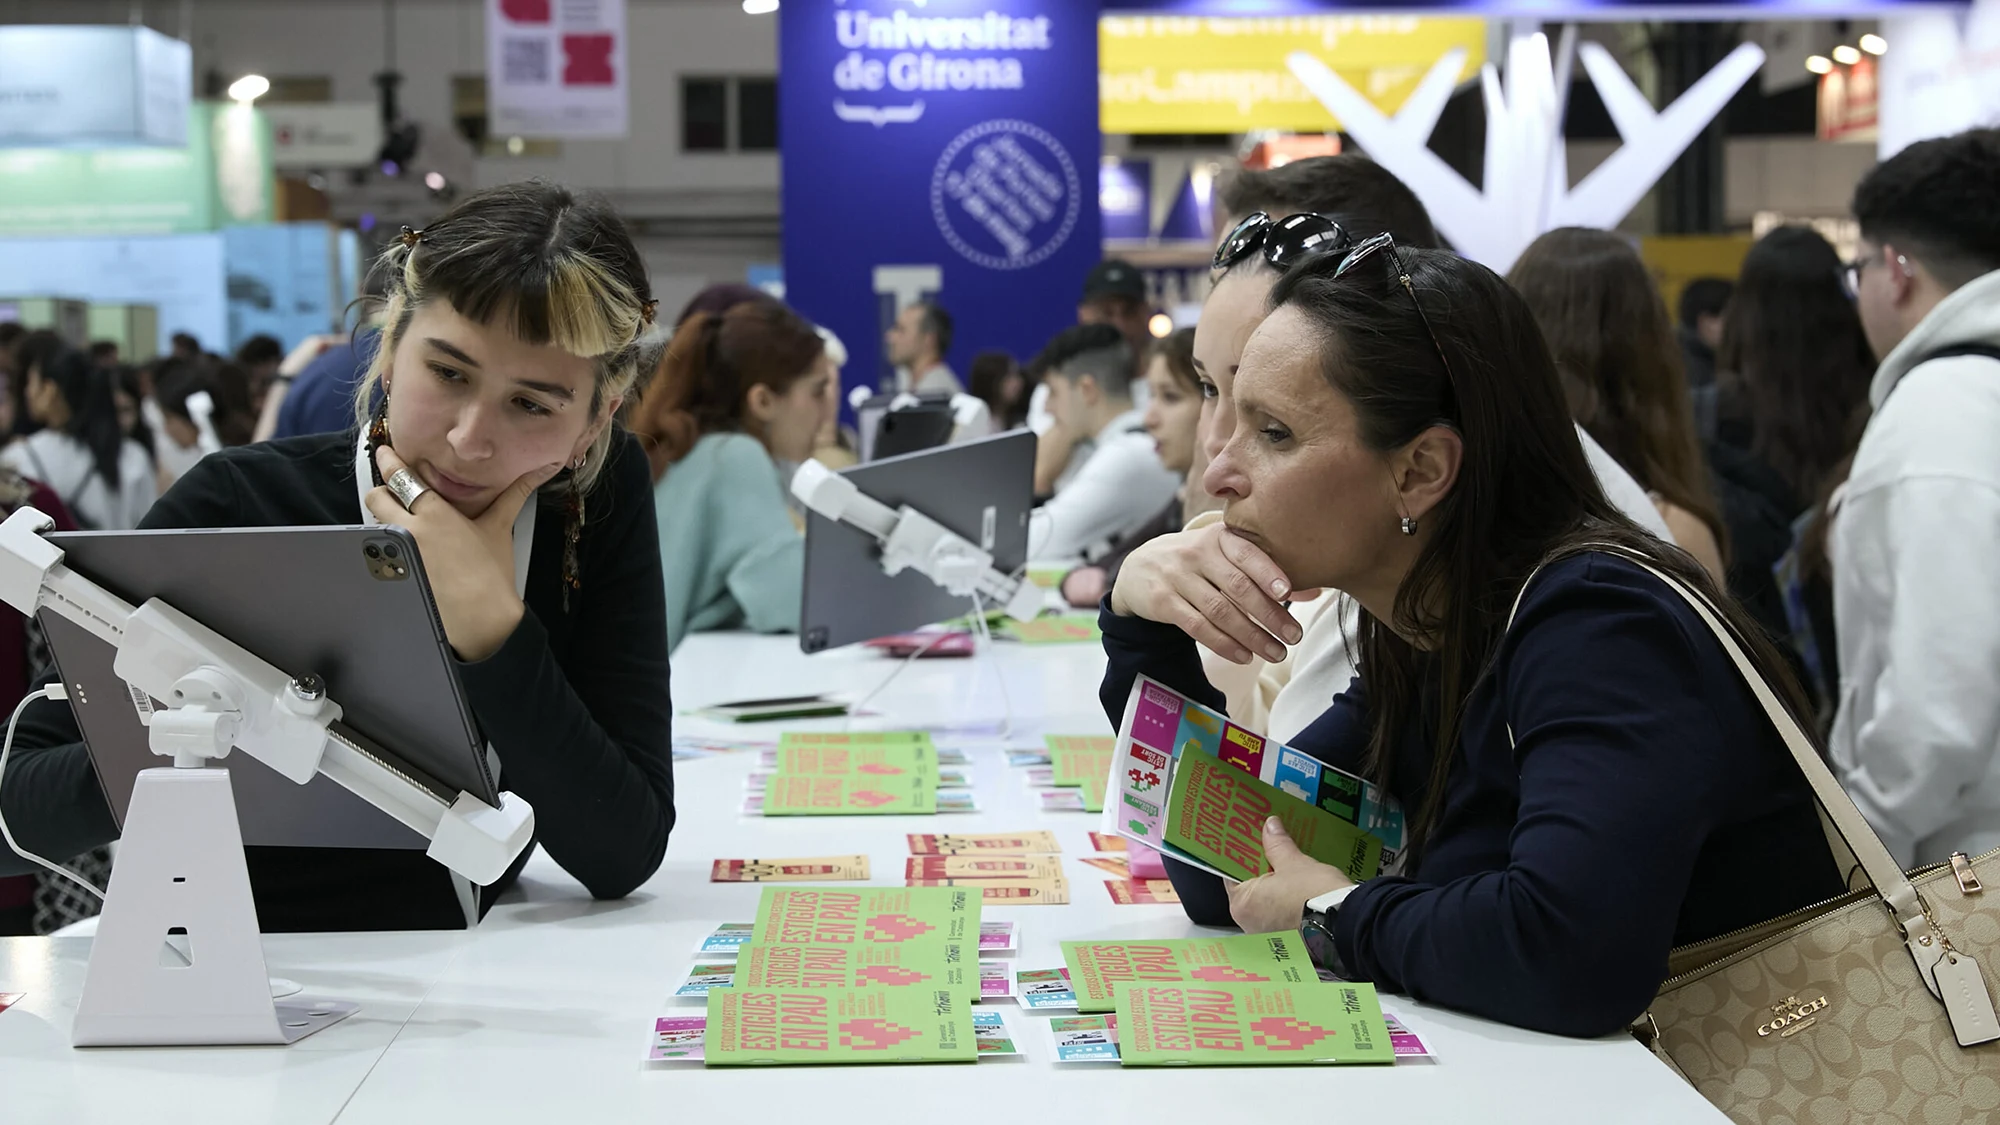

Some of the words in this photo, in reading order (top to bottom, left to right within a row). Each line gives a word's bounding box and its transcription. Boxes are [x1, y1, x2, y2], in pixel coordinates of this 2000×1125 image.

[835, 9, 1053, 50] Universitat
[833, 51, 886, 91] de
[887, 52, 1024, 91] Girona
[1141, 749, 1156, 759] SORT
[1147, 757, 1164, 768] ESTIC
[1243, 740, 1259, 751] ESTIC
[1194, 766, 1236, 856] ESTIGUES
[1228, 781, 1272, 847] PAU
[1224, 833, 1261, 876] EN
[781, 891, 819, 944] ESTIGUES
[819, 892, 861, 921] PAU
[814, 922, 856, 944] EN
[803, 948, 848, 971] PAU
[1127, 945, 1180, 973] PAU
[781, 993, 827, 1026] PAU
[1148, 987, 1192, 1051] ESTIGUES
[1186, 989, 1239, 1025] PAU
[1757, 996, 1829, 1037] COACH
[1959, 977, 1981, 1026] COACH
[741, 992, 776, 1051] ESTIGUES
[781, 1027, 828, 1051] EN
[1193, 1028, 1244, 1051] EN
